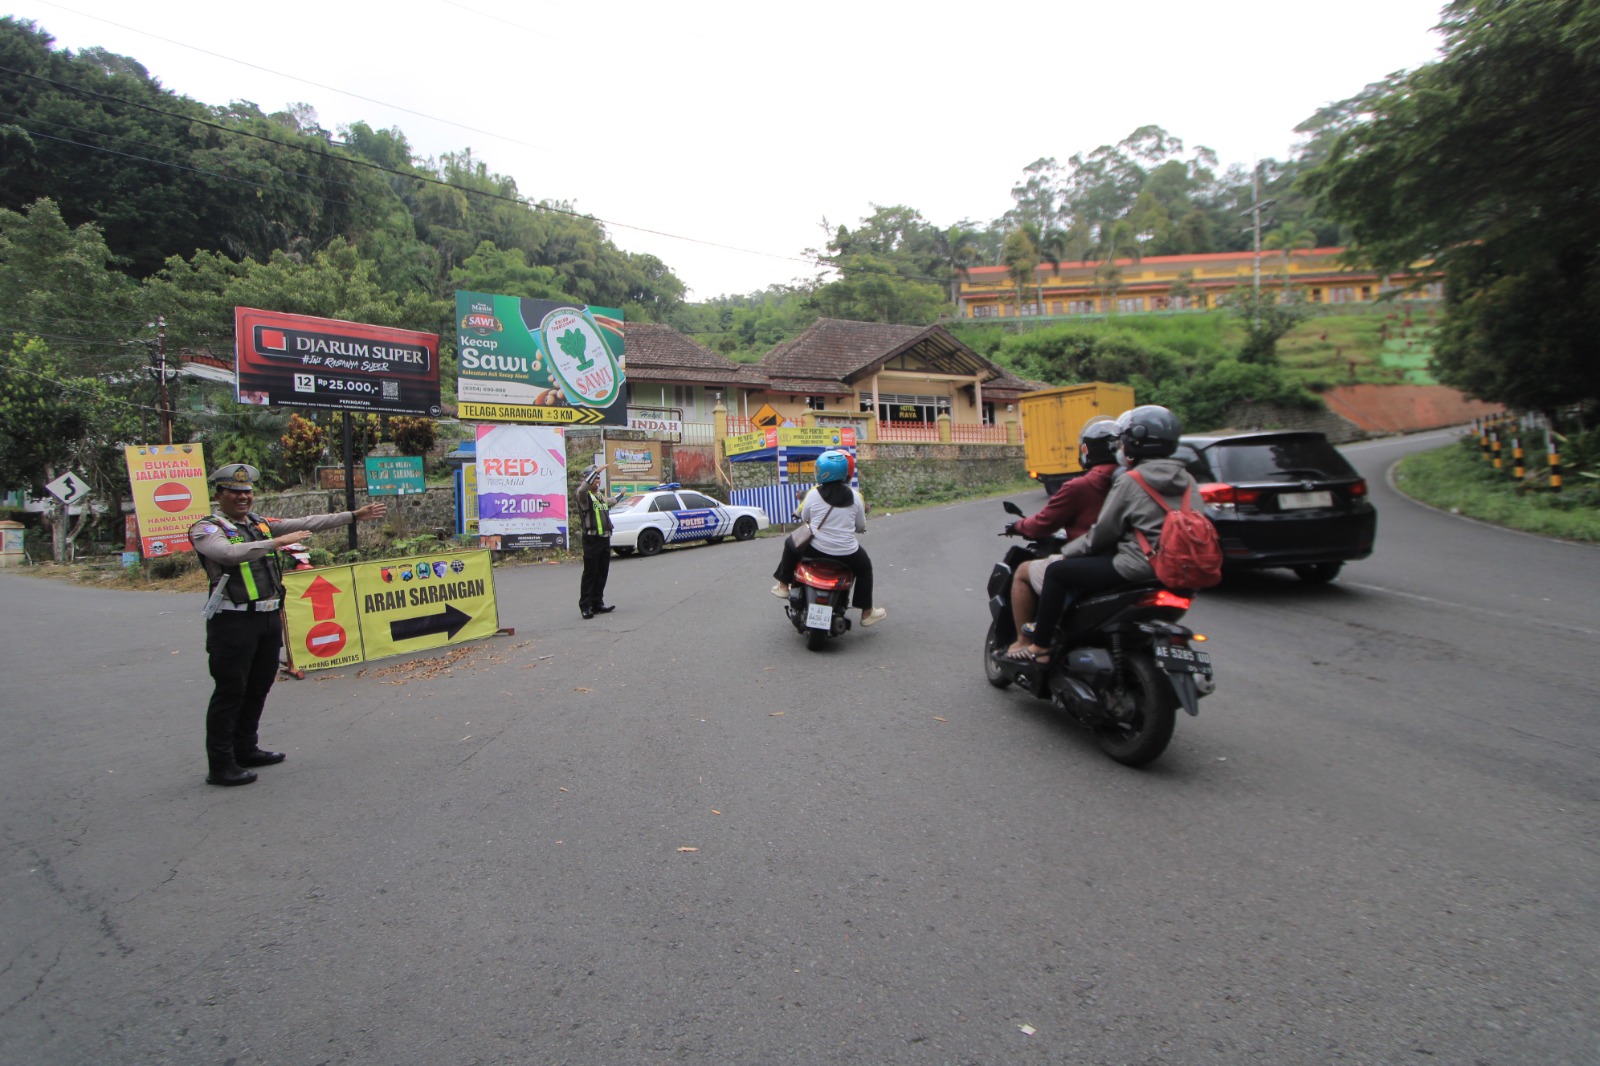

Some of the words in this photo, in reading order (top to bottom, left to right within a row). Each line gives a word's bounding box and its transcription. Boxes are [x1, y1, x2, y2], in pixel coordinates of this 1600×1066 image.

[468, 316, 494, 327] SAWI
[296, 336, 369, 358] DJARUM
[372, 346, 424, 364] SUPER
[460, 336, 498, 350] Kecap
[462, 348, 528, 372] Sawi
[298, 376, 312, 387] 12
[318, 378, 328, 386] Rp
[329, 380, 379, 394] 25.000,-
[576, 367, 612, 395] SAWI
[464, 405, 498, 417] TELAGA
[499, 406, 543, 419] SARANGAN
[632, 420, 678, 431] INDAH
[144, 460, 189, 470] BUKAN
[483, 458, 538, 476] RED
[136, 470, 169, 481] JALAN
[170, 468, 203, 479] UMUM
[504, 478, 524, 486] Mild
[502, 499, 544, 513] 22.000
[681, 518, 704, 526] POLISI
[365, 590, 406, 614] ARAH
[410, 579, 485, 606] SARANGAN
[1156, 646, 1169, 657] AE
[299, 660, 329, 670] DARANG
[330, 654, 359, 666] MELINTAS
